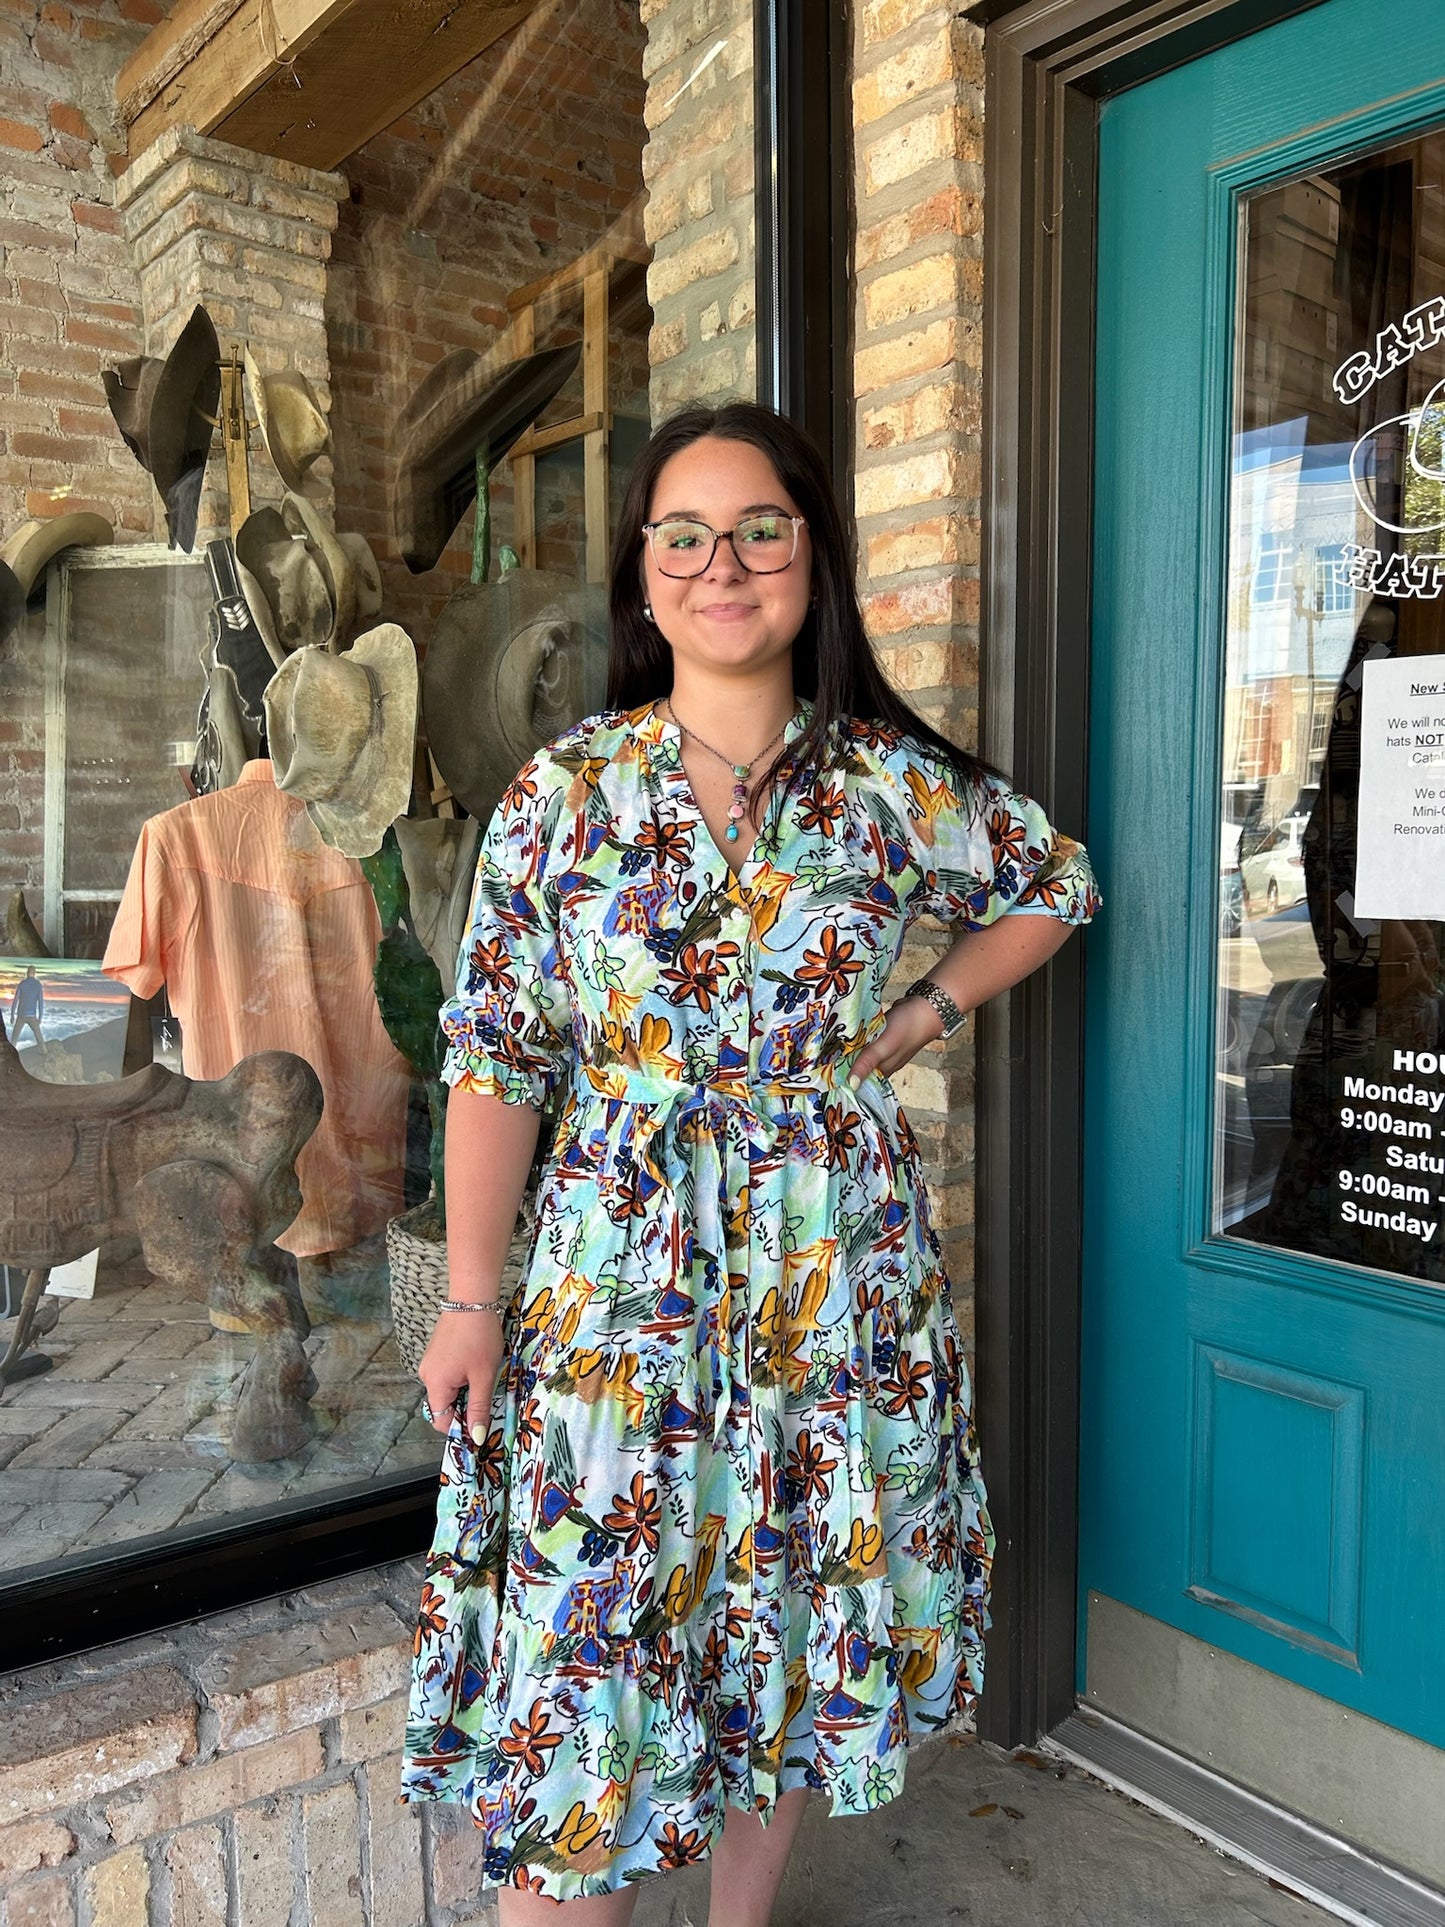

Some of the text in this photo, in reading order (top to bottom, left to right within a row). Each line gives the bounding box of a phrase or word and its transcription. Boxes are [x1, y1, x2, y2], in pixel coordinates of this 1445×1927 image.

[1333, 296, 1445, 404] CAT
[1410, 683, 1439, 696] New
[1388, 718, 1408, 729] We
[1411, 716, 1430, 728] will
[1386, 733, 1444, 747] hats NOT
[1412, 751, 1445, 764] Catal
[1415, 788, 1435, 799] We
[1344, 1076, 1445, 1113] Monday
[1340, 1107, 1432, 1140] 9:00am
[1386, 1145, 1444, 1175] Satu
[1339, 1169, 1430, 1205] 9:00am
[1340, 1201, 1438, 1242] Sunday
